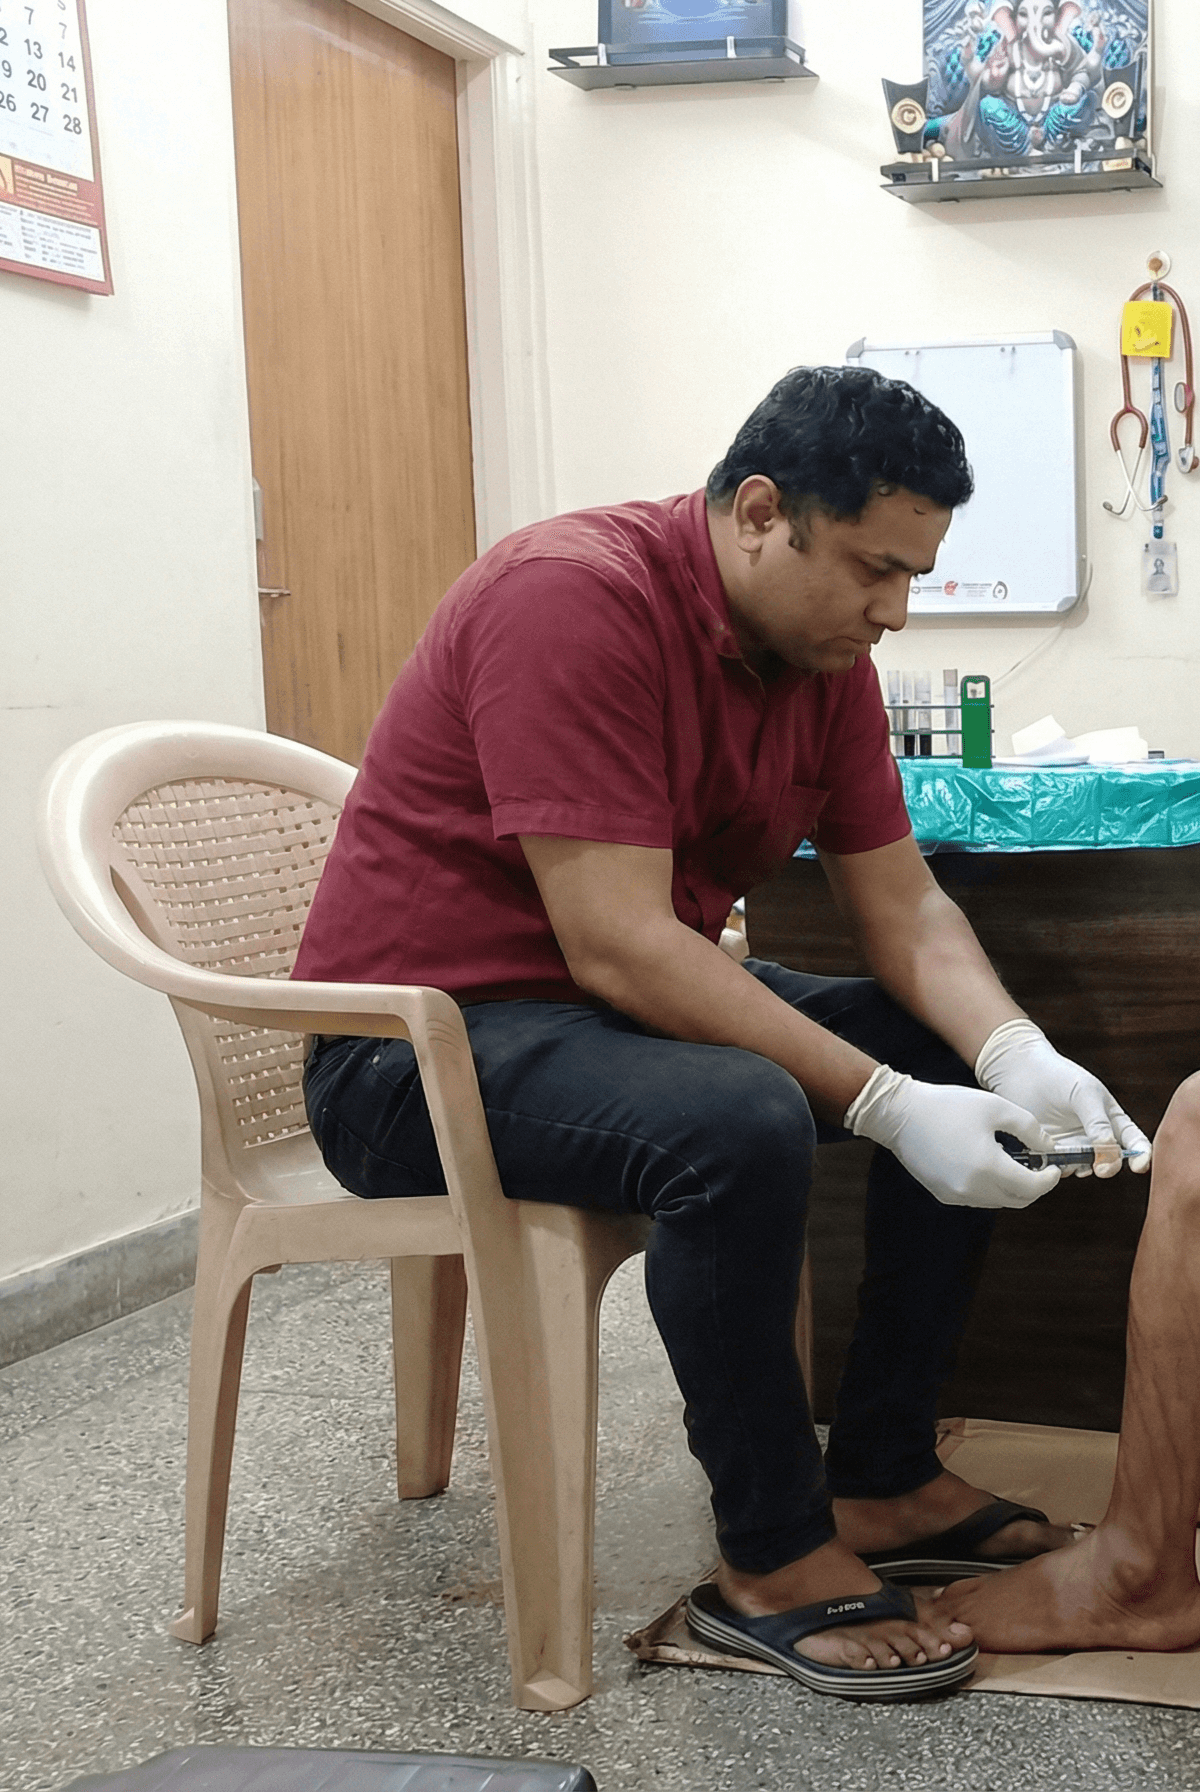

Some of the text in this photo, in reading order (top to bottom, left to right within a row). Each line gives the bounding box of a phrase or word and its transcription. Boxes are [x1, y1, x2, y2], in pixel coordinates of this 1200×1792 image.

[24, 6, 67, 39] 7 7
[24, 38, 43, 59] 13
[58, 51, 76, 72] 14
[27, 69, 46, 91] 20
[60, 82, 78, 103] 21
[30, 102, 49, 122] 27
[63, 114, 82, 135] 28
